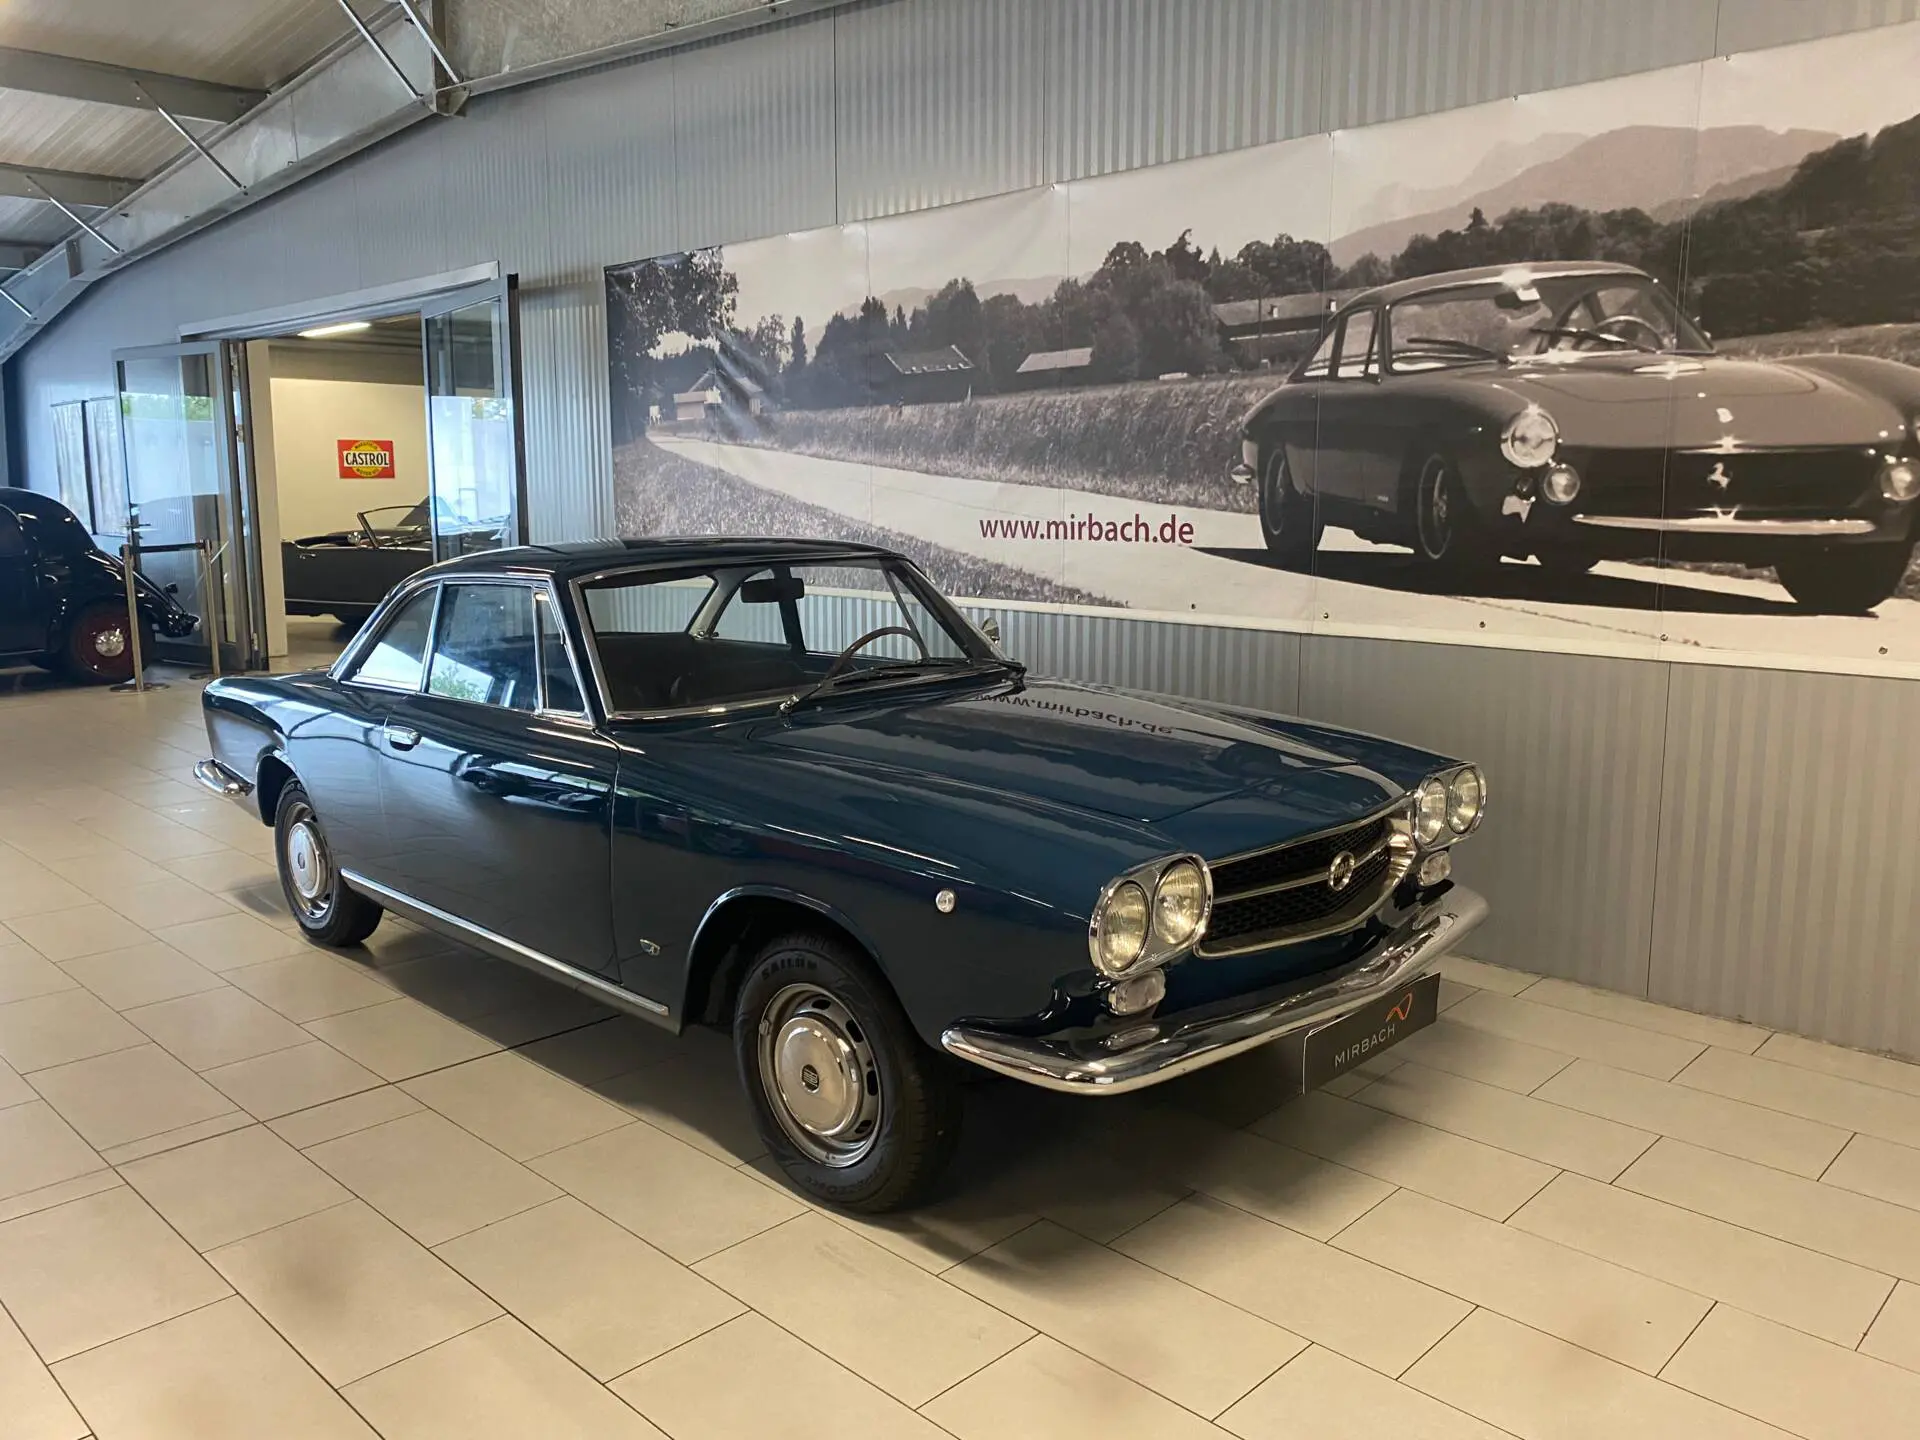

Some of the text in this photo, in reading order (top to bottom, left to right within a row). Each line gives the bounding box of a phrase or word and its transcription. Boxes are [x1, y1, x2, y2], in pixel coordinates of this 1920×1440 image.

[345, 452, 389, 466] CASTROL
[979, 513, 1195, 543] www.mirbach.de
[1334, 1023, 1395, 1068] MIRBACH
